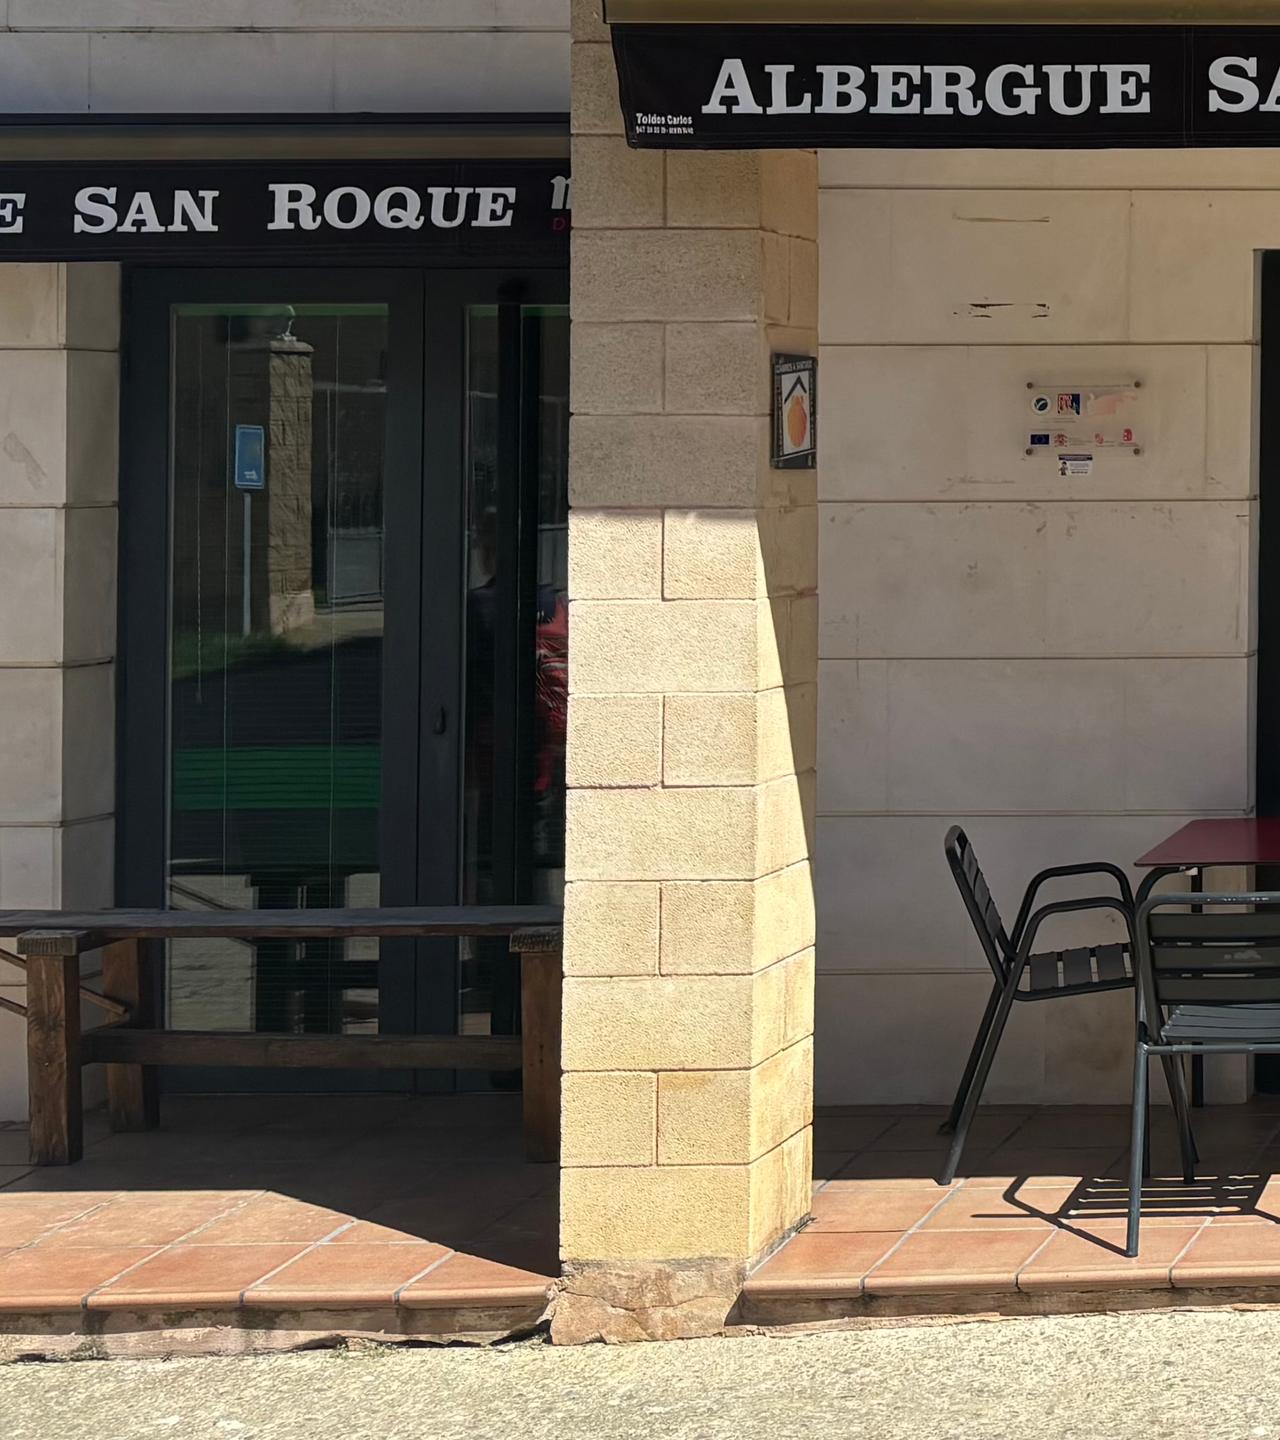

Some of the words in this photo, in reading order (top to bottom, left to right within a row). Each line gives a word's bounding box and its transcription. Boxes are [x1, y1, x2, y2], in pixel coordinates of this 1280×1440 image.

[701, 58, 1151, 116] ALBERGUE
[73, 186, 219, 234] SAN
[267, 183, 516, 231] ROQUE
